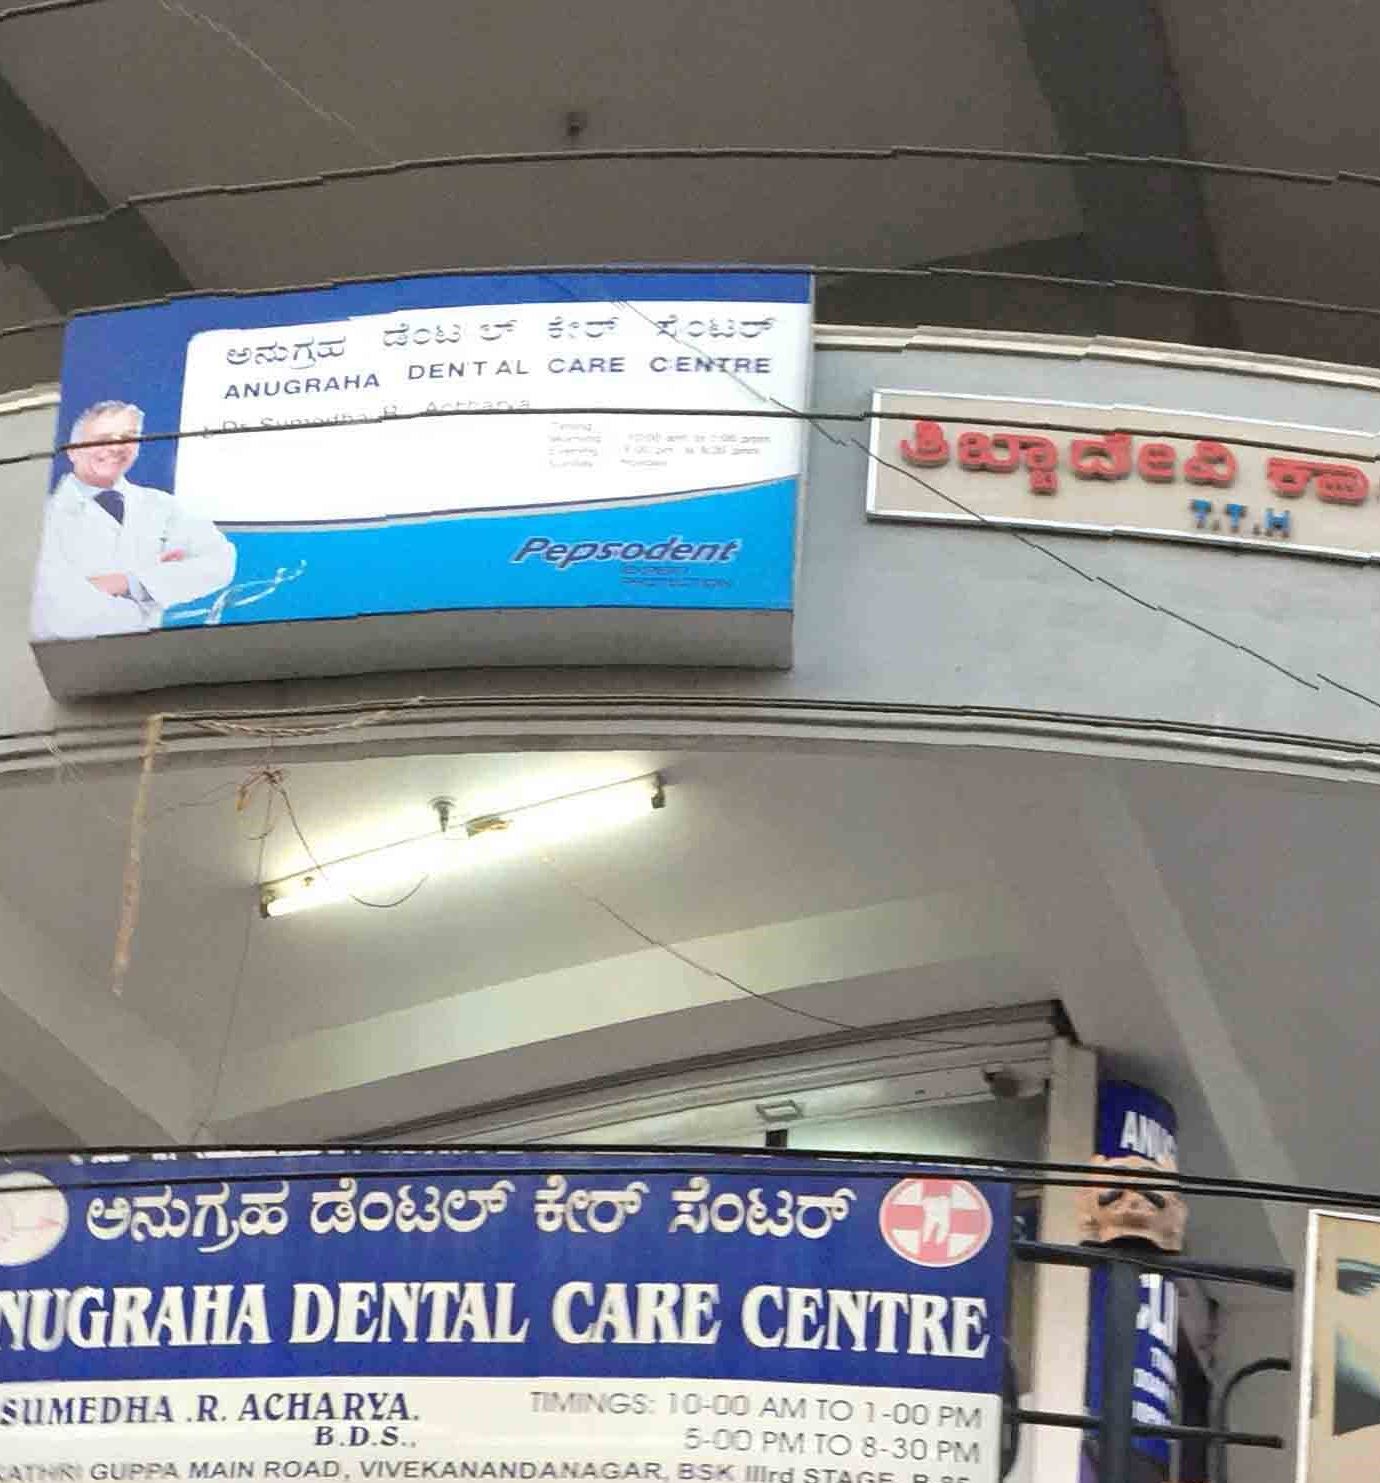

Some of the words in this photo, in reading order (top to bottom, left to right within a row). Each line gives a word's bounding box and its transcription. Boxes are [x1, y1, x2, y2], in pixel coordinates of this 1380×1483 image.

[224, 372, 380, 400] ANUGRAHA
[408, 359, 530, 381] DENTAL
[547, 356, 626, 374] CARE
[649, 356, 773, 374] CENTRE
[510, 536, 743, 570] Pepsodent
[86, 1180, 290, 1254] ಅನುಗ್ರಹ
[310, 1176, 517, 1238] ಡೆಂಟಲ್
[534, 1174, 650, 1234] ಕೇರ್
[669, 1175, 858, 1240] ಸೆಂಟರ್
[288, 1280, 531, 1347] DENTAL
[552, 1280, 722, 1346] CARE
[741, 1284, 991, 1361] CENTRE
[0, 1395, 175, 1427] SUMEDHA
[238, 1391, 421, 1424] ACHARYA.
[529, 1391, 656, 1416] TIMINGS:
[667, 1392, 751, 1417] 10-00
[758, 1395, 807, 1420] AM
[819, 1399, 853, 1423] TO
[865, 1403, 930, 1427] 1-00
[938, 1406, 983, 1431] PM
[684, 1428, 754, 1453] 5-00
[763, 1431, 806, 1455] PM
[819, 1434, 851, 1458] TO
[862, 1437, 929, 1462] 8-30
[936, 1440, 981, 1465] PM
[188, 1460, 255, 1480] MAIN
[265, 1459, 351, 1482] ROAD,
[359, 1459, 670, 1483] VIVEKANANDANAGAR,
[678, 1461, 736, 1483] BSK
